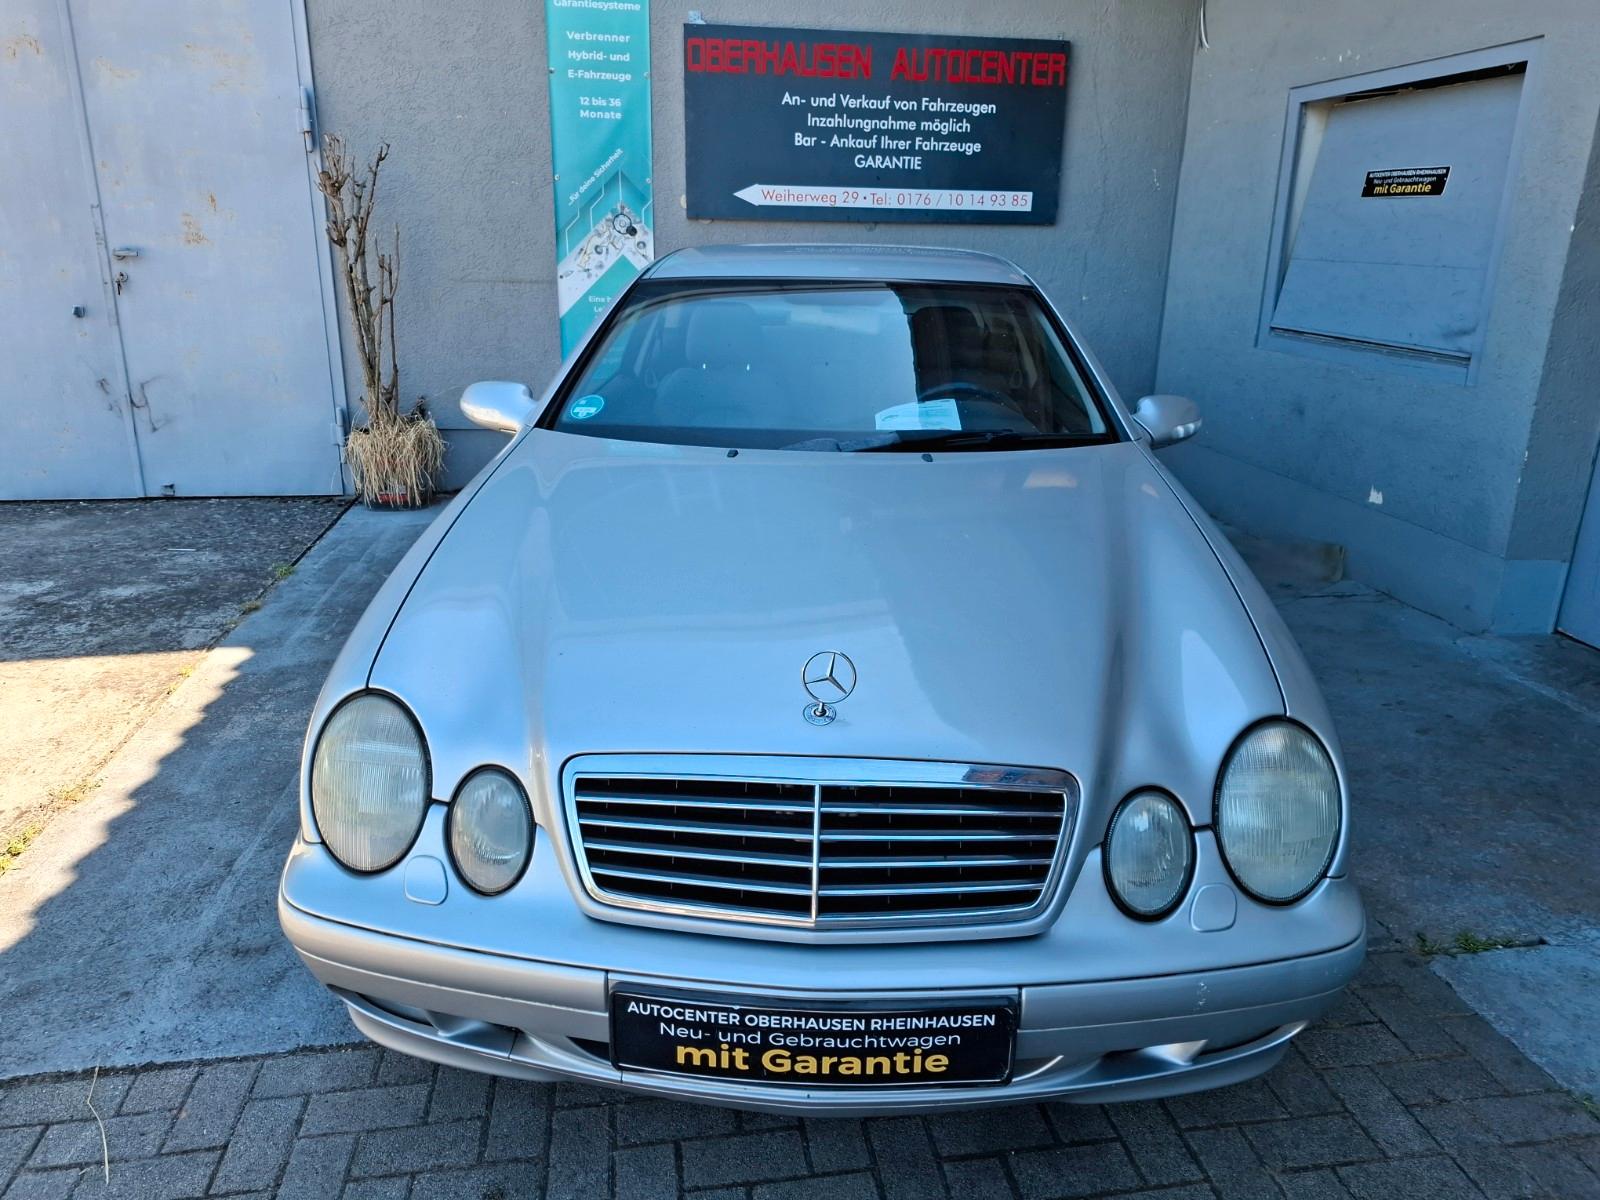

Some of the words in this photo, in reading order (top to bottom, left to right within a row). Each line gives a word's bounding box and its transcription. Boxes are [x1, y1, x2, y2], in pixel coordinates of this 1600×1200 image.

[566, 31, 631, 42] Verbrenner
[568, 50, 607, 61] Hybrid-
[609, 52, 630, 61] und
[686, 37, 872, 80] OBERHAUSEN
[890, 47, 1066, 86] AUTOCENTER
[567, 69, 632, 82] E-Fahrzeuge
[579, 97, 591, 105] 12
[592, 97, 606, 106] bis
[609, 98, 622, 107] 36
[781, 91, 806, 106] An-
[811, 93, 836, 108] und
[840, 94, 892, 109] Verkauf
[894, 100, 917, 111] von
[921, 97, 997, 116] Fahrzeugen
[580, 110, 622, 119] Monate
[807, 113, 917, 132] Inzahlungnahme
[920, 118, 971, 135] möglich
[794, 132, 817, 147] Bar
[830, 134, 878, 149] Ankauf
[881, 135, 911, 150] Ihrer
[915, 137, 981, 155] Fahrzeuge
[854, 154, 922, 170] GARANTIE
[1373, 184, 1388, 194] mit
[1389, 183, 1432, 193] Garantie
[761, 189, 837, 207] Weiherweg
[842, 191, 859, 204] 29
[897, 193, 931, 206] 0176
[949, 194, 964, 206] 10
[970, 194, 985, 206] 14
[990, 194, 1006, 207] 93
[1011, 194, 1028, 207] 85
[627, 1001, 740, 1025] AUTOCENTER
[745, 1014, 865, 1031] OBERHAUSEN
[871, 1014, 996, 1031] RHEINHAUSEN
[660, 1022, 711, 1040] Neu-
[718, 1031, 761, 1045] und
[769, 1032, 961, 1050] Gebrauchtwagen
[676, 1043, 749, 1070] mit
[761, 1048, 949, 1075] Garantie
